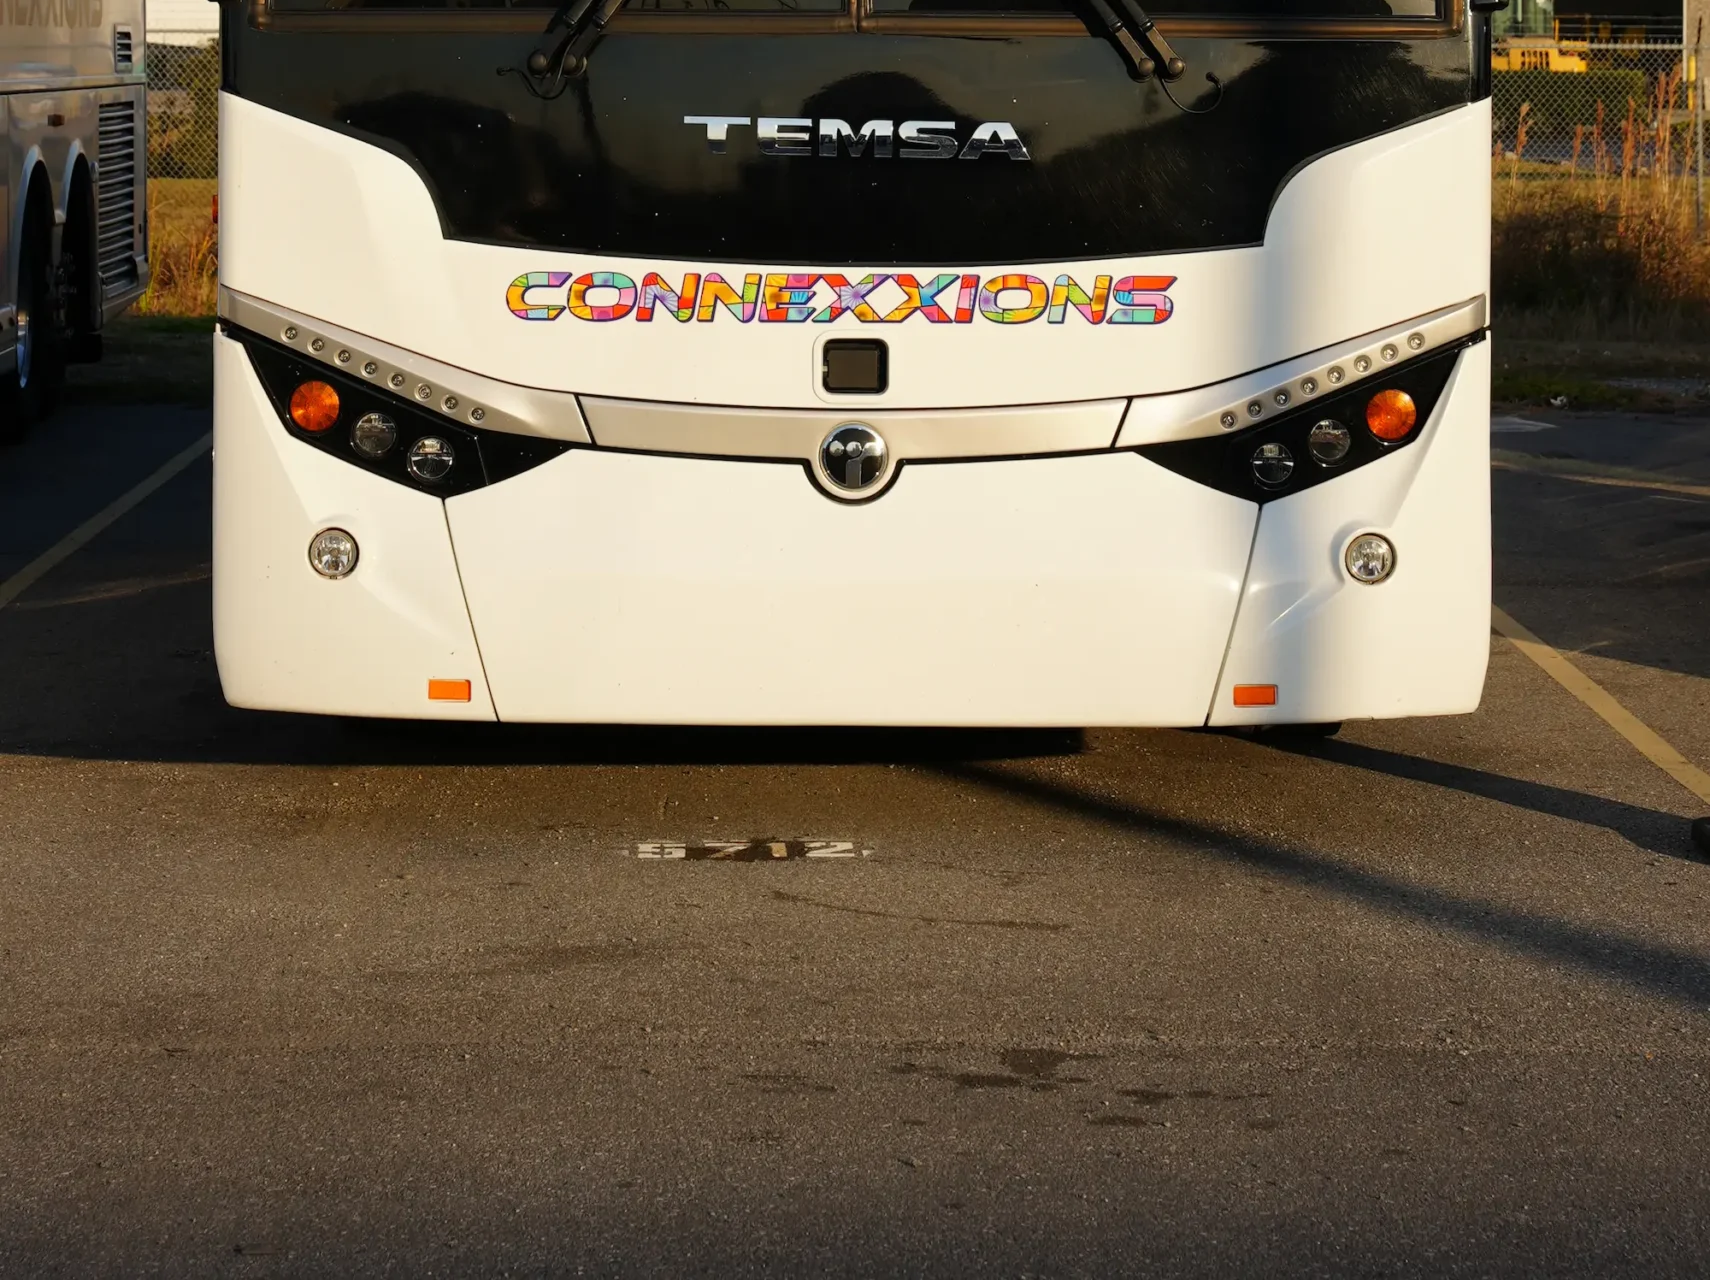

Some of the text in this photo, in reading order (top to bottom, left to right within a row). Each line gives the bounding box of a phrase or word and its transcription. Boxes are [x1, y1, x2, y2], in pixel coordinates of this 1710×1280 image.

[684, 115, 1031, 161] TEMSA
[505, 271, 1178, 324] CONNEXXIONS
[638, 841, 855, 859] 5712
